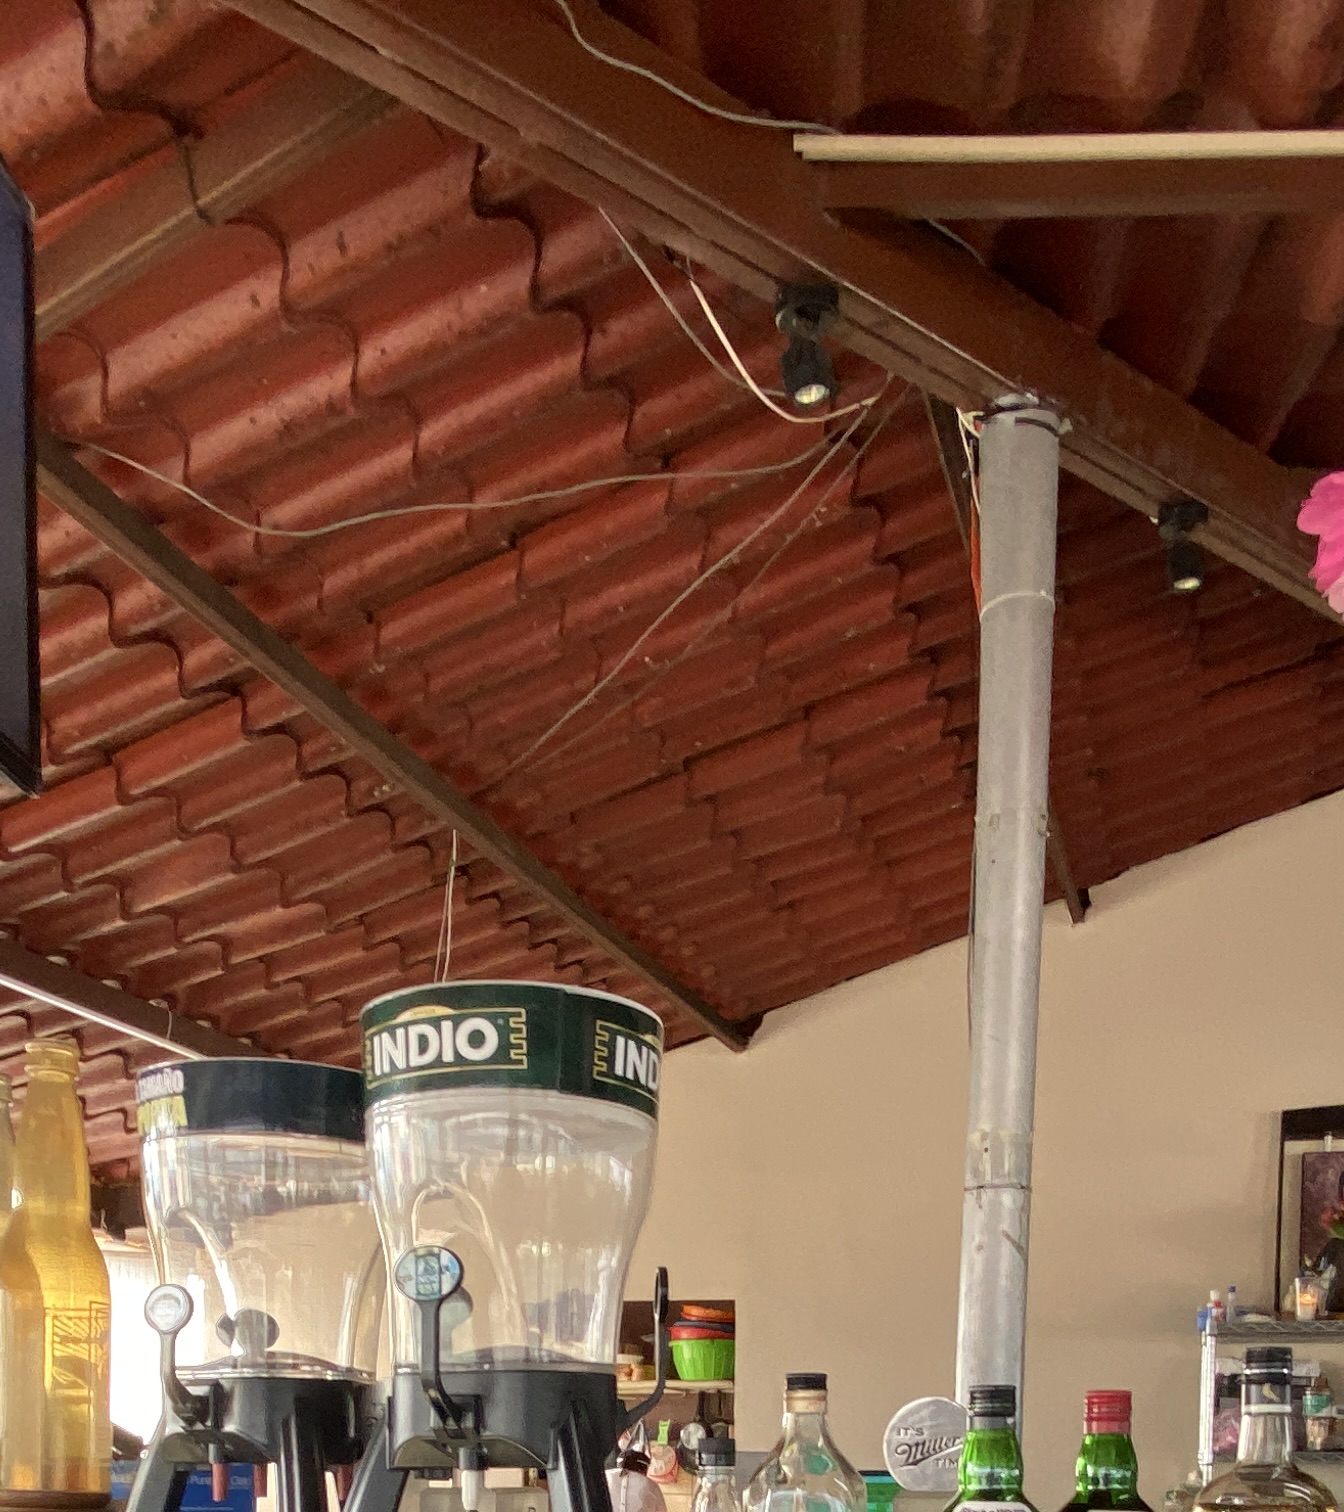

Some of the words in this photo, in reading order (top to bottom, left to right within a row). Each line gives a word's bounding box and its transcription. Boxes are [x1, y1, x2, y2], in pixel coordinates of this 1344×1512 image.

[372, 1016, 499, 1077] INDIO
[613, 1034, 660, 1092] IND
[894, 1436, 962, 1468] Miller
[934, 1457, 959, 1469] TIM
